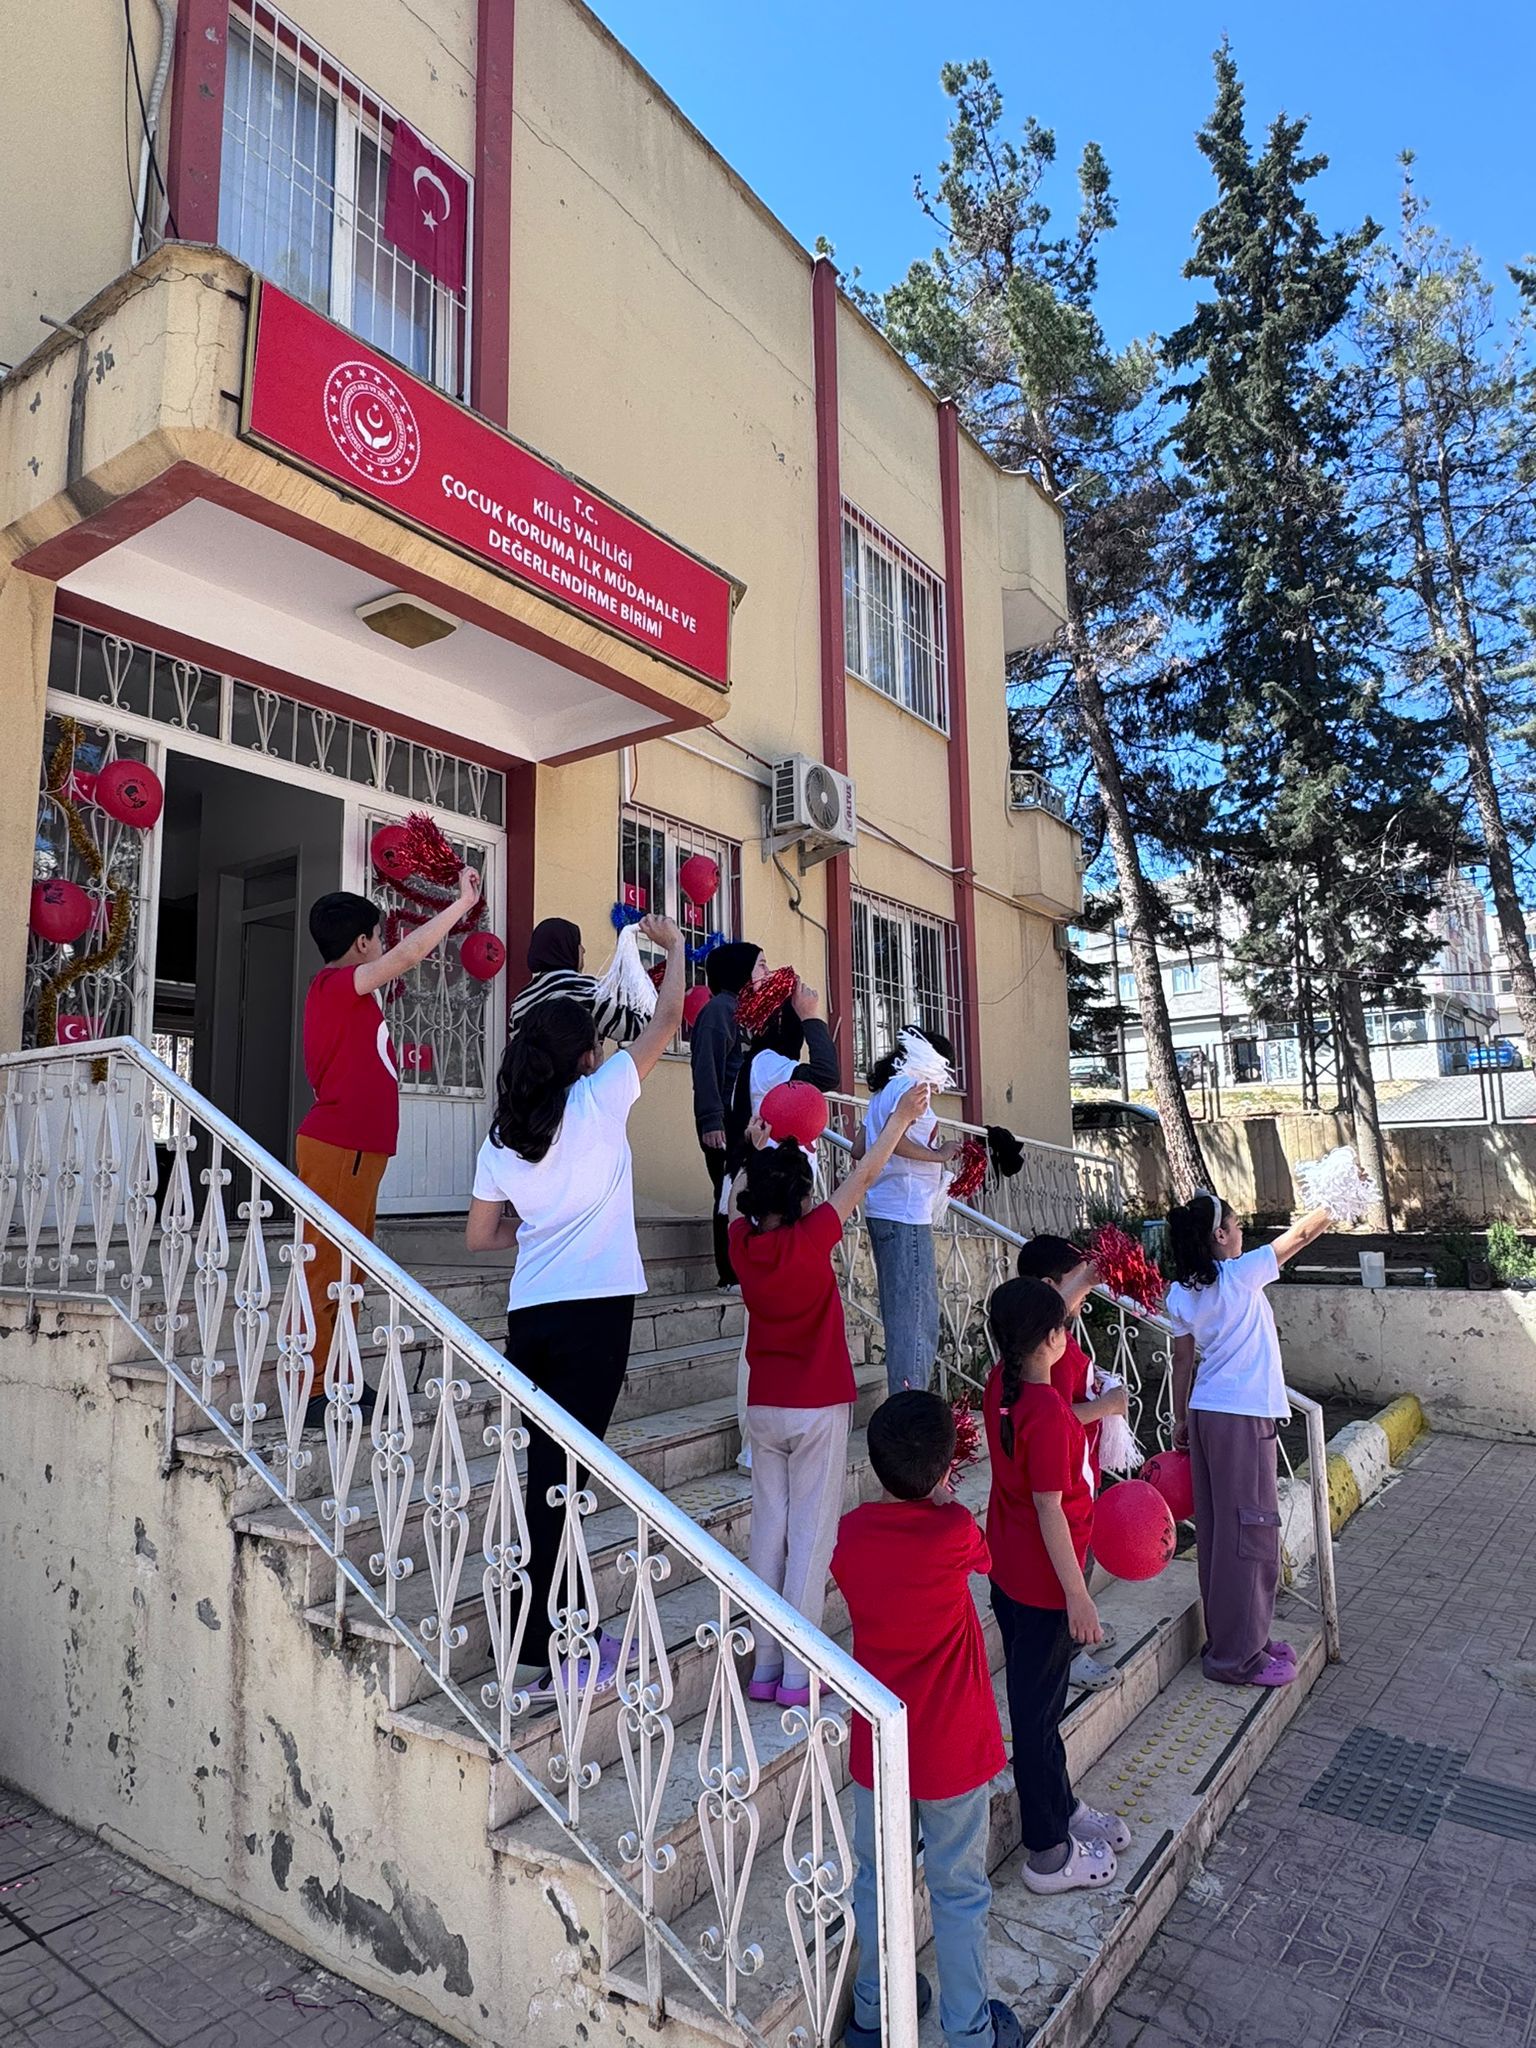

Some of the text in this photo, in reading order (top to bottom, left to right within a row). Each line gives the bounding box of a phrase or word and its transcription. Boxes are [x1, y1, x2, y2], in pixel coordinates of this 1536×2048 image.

[441, 474, 696, 633] ÇOCUK KORUMA İLK MÜDAHALE VE
[533, 497, 632, 571] KİLİS VALİLİĞİ
[573, 495, 598, 525] T.C.
[489, 528, 663, 639] DEĞERLENDİRME BİRİMİ
